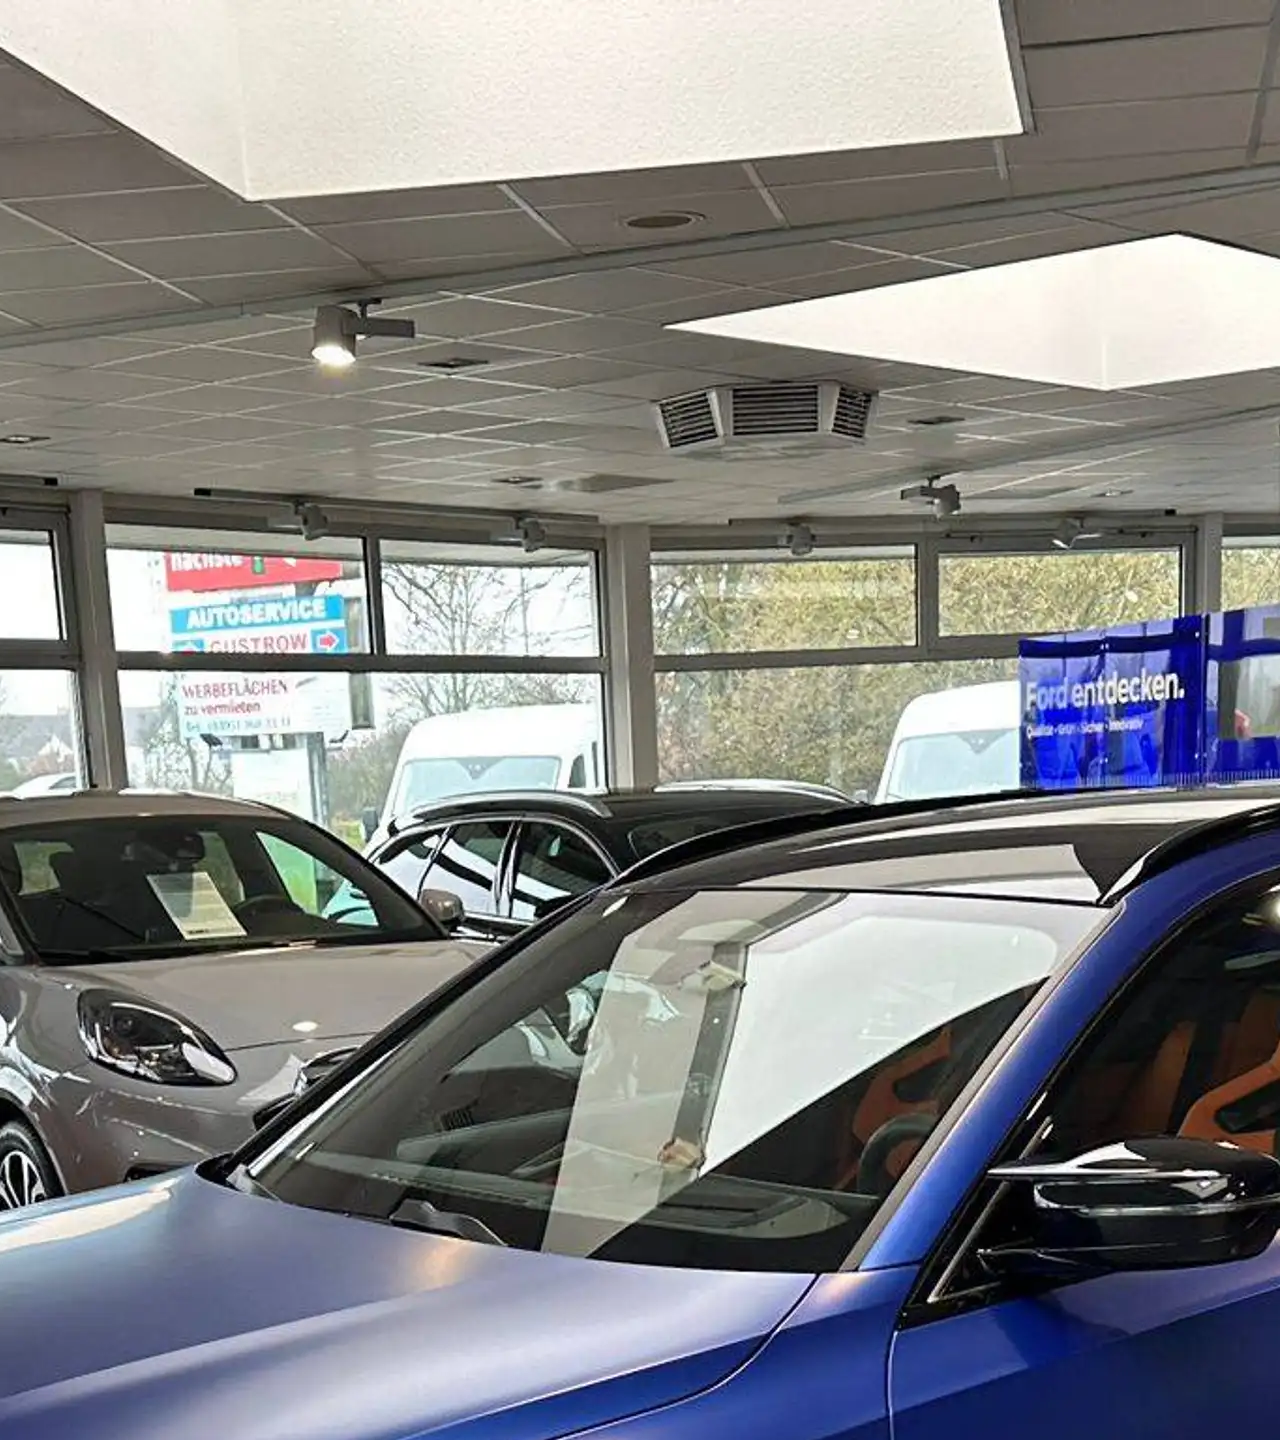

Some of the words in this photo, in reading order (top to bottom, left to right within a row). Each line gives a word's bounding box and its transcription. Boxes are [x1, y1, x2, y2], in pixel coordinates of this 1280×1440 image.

[187, 598, 326, 631] AUTOSERVICE
[182, 678, 289, 699] WERBEFLÄCHEN
[1026, 677, 1069, 711] Ford
[1071, 668, 1185, 708] entdecken.
[200, 700, 261, 715] vermieten
